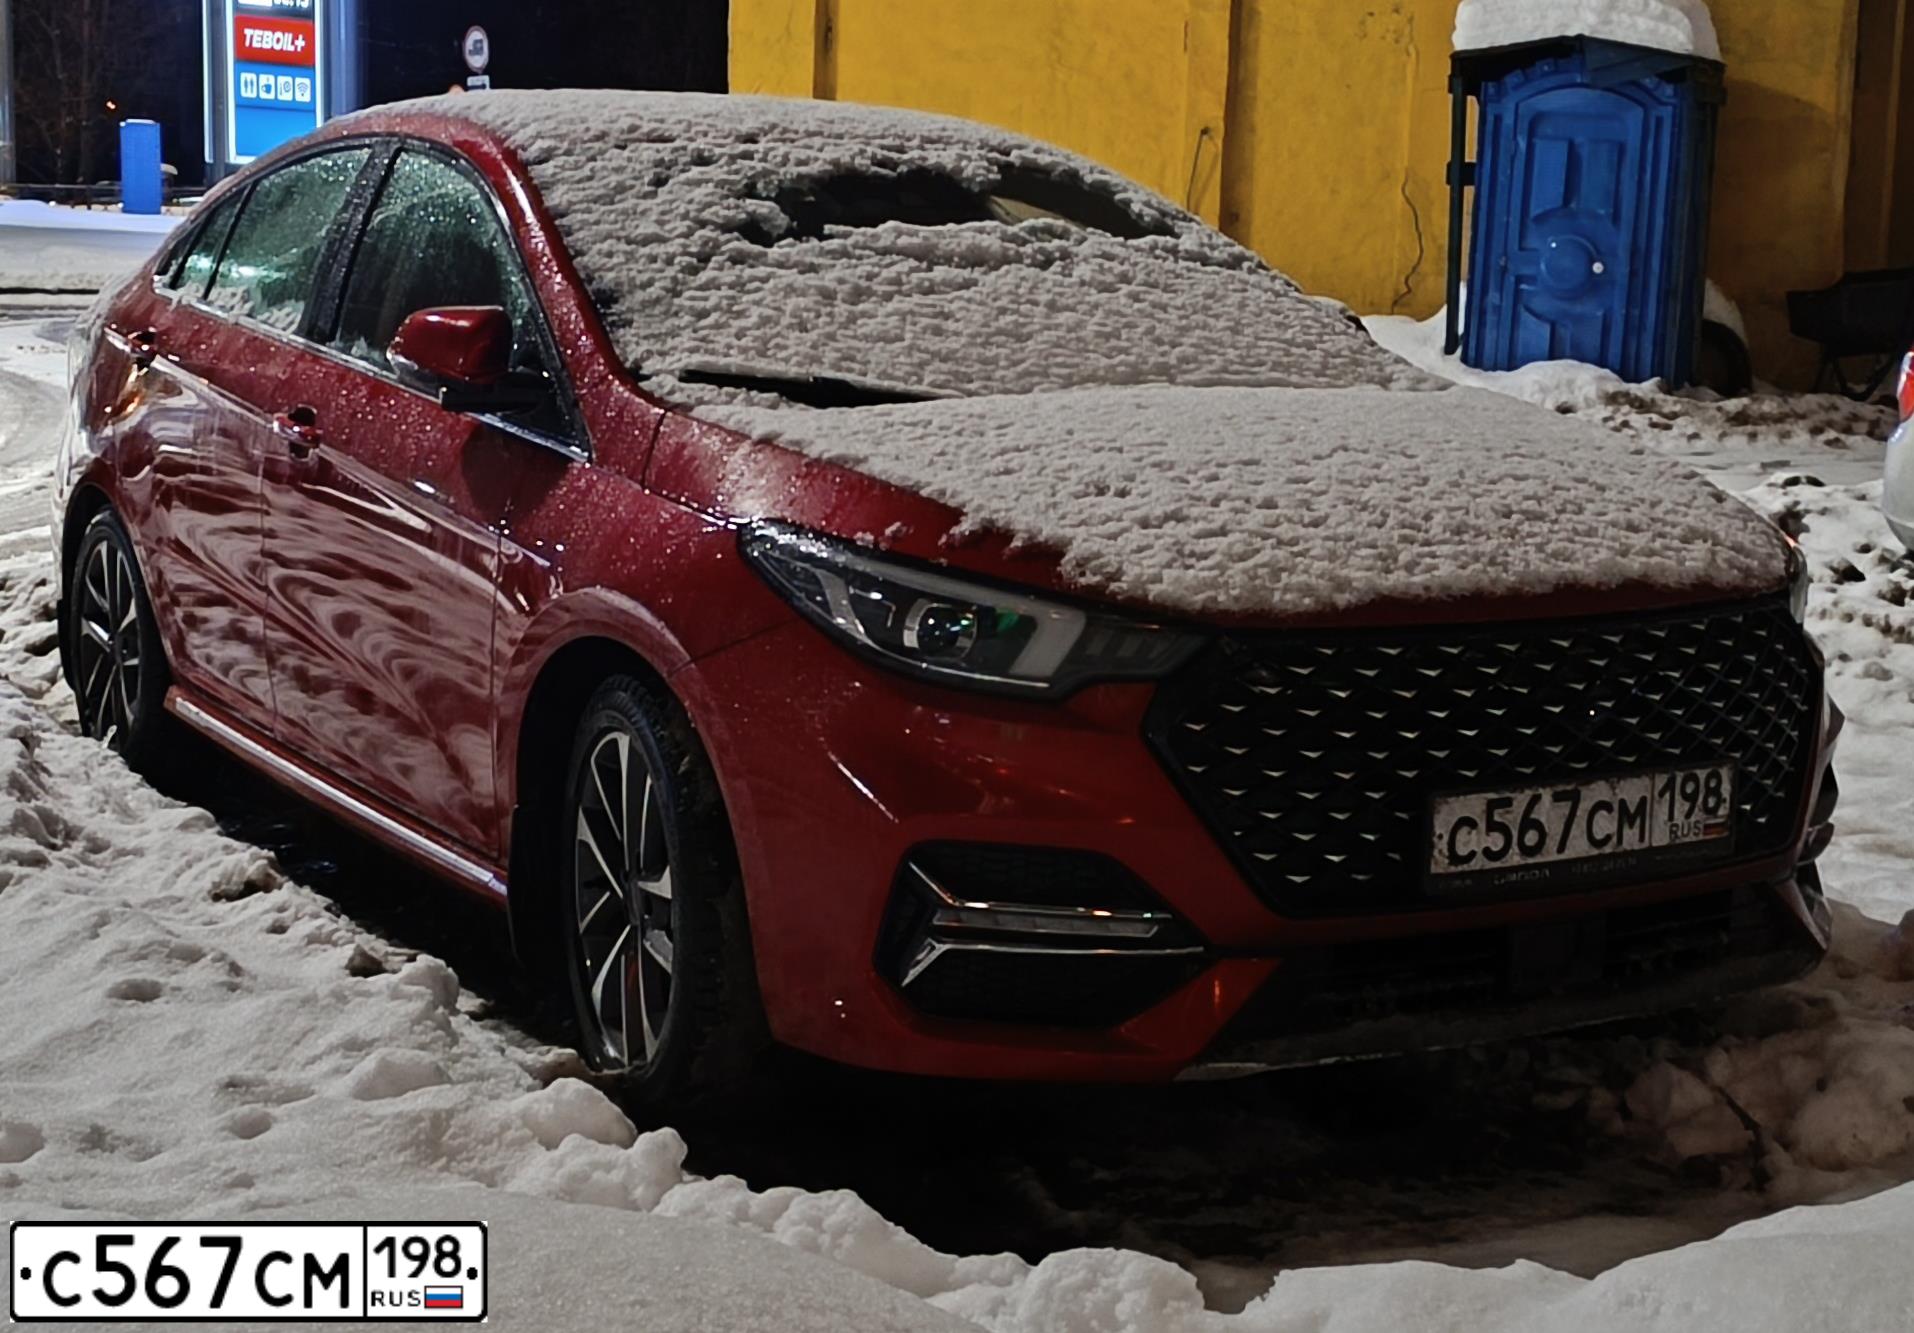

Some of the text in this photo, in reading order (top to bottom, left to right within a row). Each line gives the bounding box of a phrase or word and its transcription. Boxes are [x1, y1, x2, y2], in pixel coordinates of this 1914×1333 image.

[243, 28, 306, 52] TEBOIL+
[1658, 769, 1723, 822] 198
[1668, 818, 1702, 843] RUS
